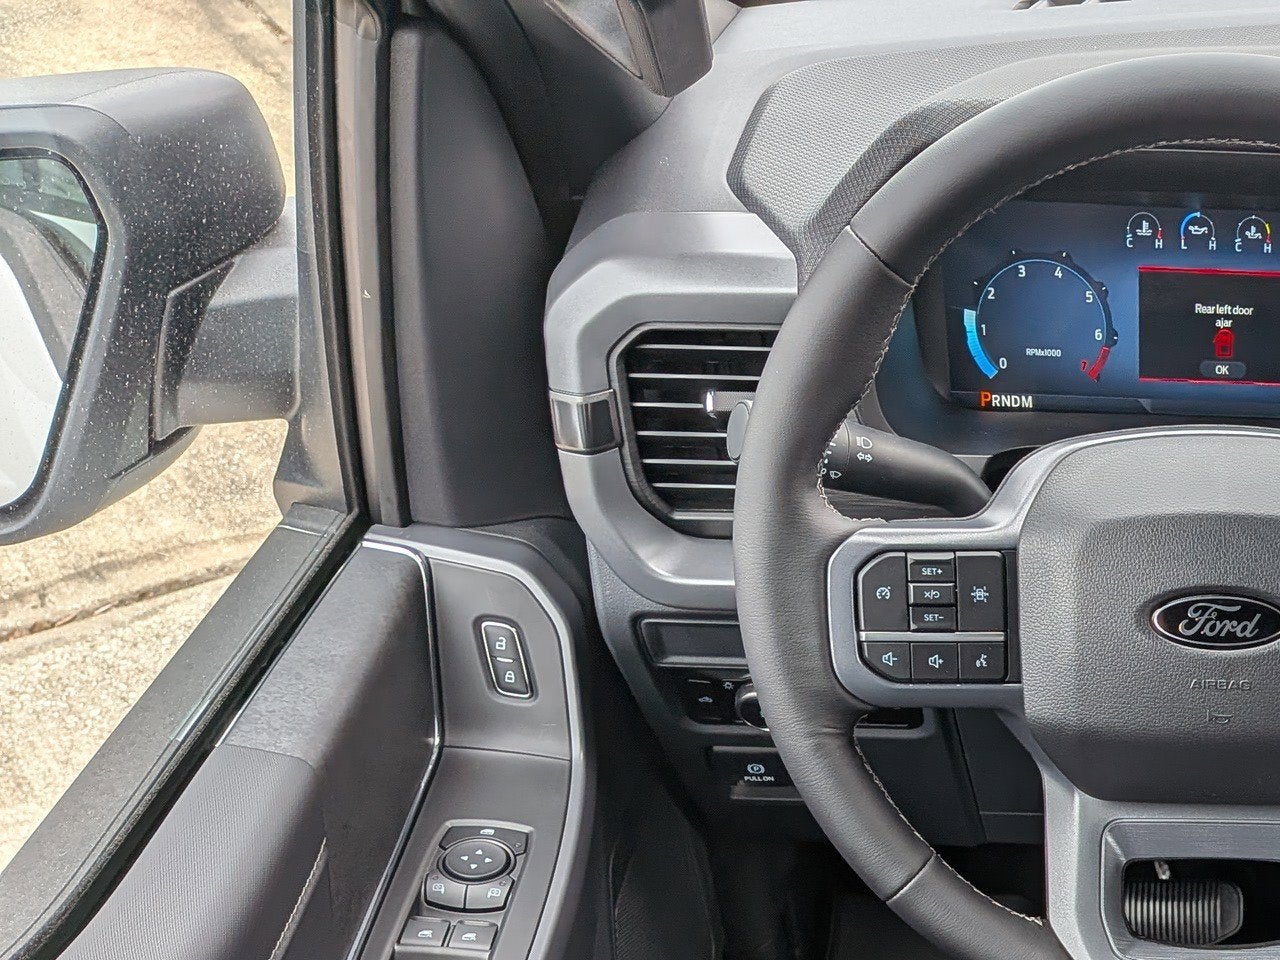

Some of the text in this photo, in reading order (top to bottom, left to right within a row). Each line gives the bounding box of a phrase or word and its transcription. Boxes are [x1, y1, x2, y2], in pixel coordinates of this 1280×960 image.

[1155, 239, 1163, 249] H
[1209, 241, 1217, 250] H
[1264, 244, 1271, 253] H
[1018, 265, 1026, 277] 3
[1054, 266, 1063, 279] 4
[987, 288, 995, 299] 2
[1086, 291, 1093, 303] 5
[1195, 303, 1254, 315] Rear left door
[1215, 318, 1233, 328] ajar
[981, 324, 987, 335] 1
[1095, 329, 1103, 340] 6
[999, 358, 1007, 369] 0
[1215, 365, 1229, 375] OK
[1178, 602, 1262, 638] Ford
[1189, 679, 1251, 691] AIRBAG
